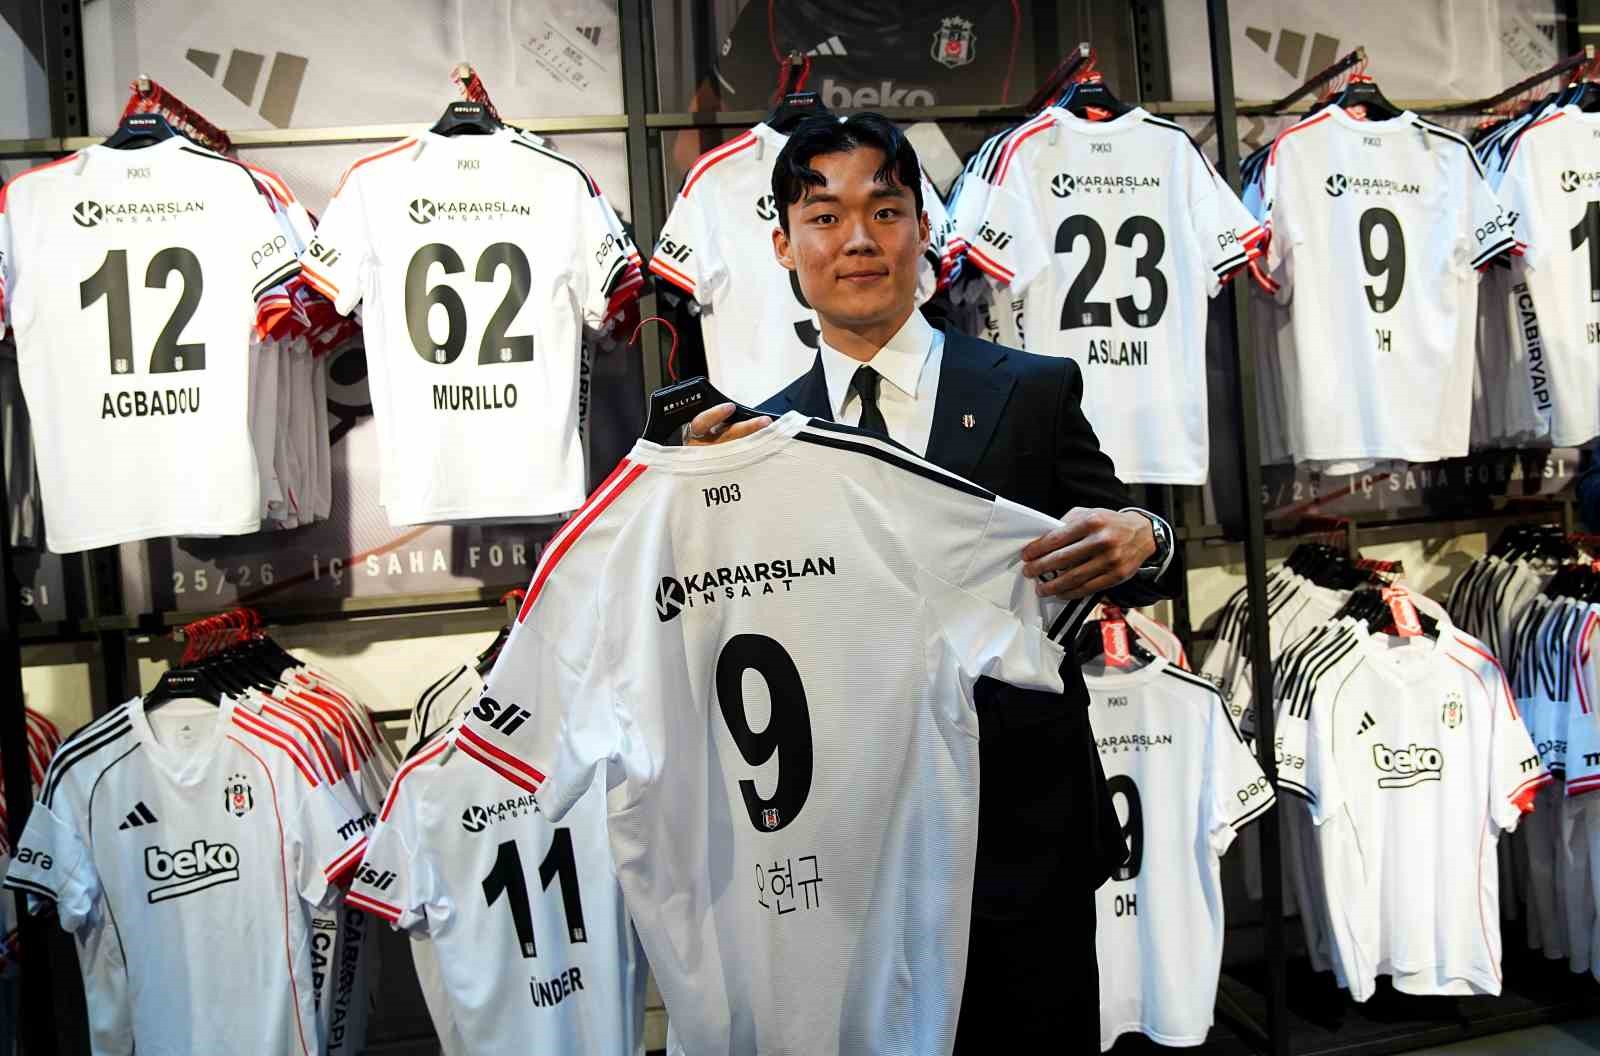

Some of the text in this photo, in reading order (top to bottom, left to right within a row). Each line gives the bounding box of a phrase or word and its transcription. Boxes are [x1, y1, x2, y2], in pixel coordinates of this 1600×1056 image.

[822, 79, 934, 108] beko
[1090, 142, 1112, 153] 1903
[127, 168, 151, 179] 1903
[457, 159, 480, 170] 1903
[978, 221, 1013, 250] isli
[1054, 214, 1168, 331] 23
[1359, 207, 1405, 313] 9
[80, 247, 206, 375] 12
[405, 242, 534, 365] 62
[102, 387, 200, 419] AGBADOU
[433, 384, 518, 411] MURILLO
[702, 483, 742, 507] 1903
[1389, 468, 1448, 491] SAHA
[173, 563, 273, 594] 25/26
[313, 555, 344, 585] İÇ
[366, 549, 448, 577] SAHA
[716, 634, 813, 832] 9
[1373, 744, 1443, 774] beko
[145, 840, 240, 881] beko
[354, 862, 397, 891] isli
[755, 856, 823, 914] 오현규
[482, 827, 587, 958] 11
[1114, 893, 1138, 918] OH
[529, 967, 584, 1008] ÜNDER
